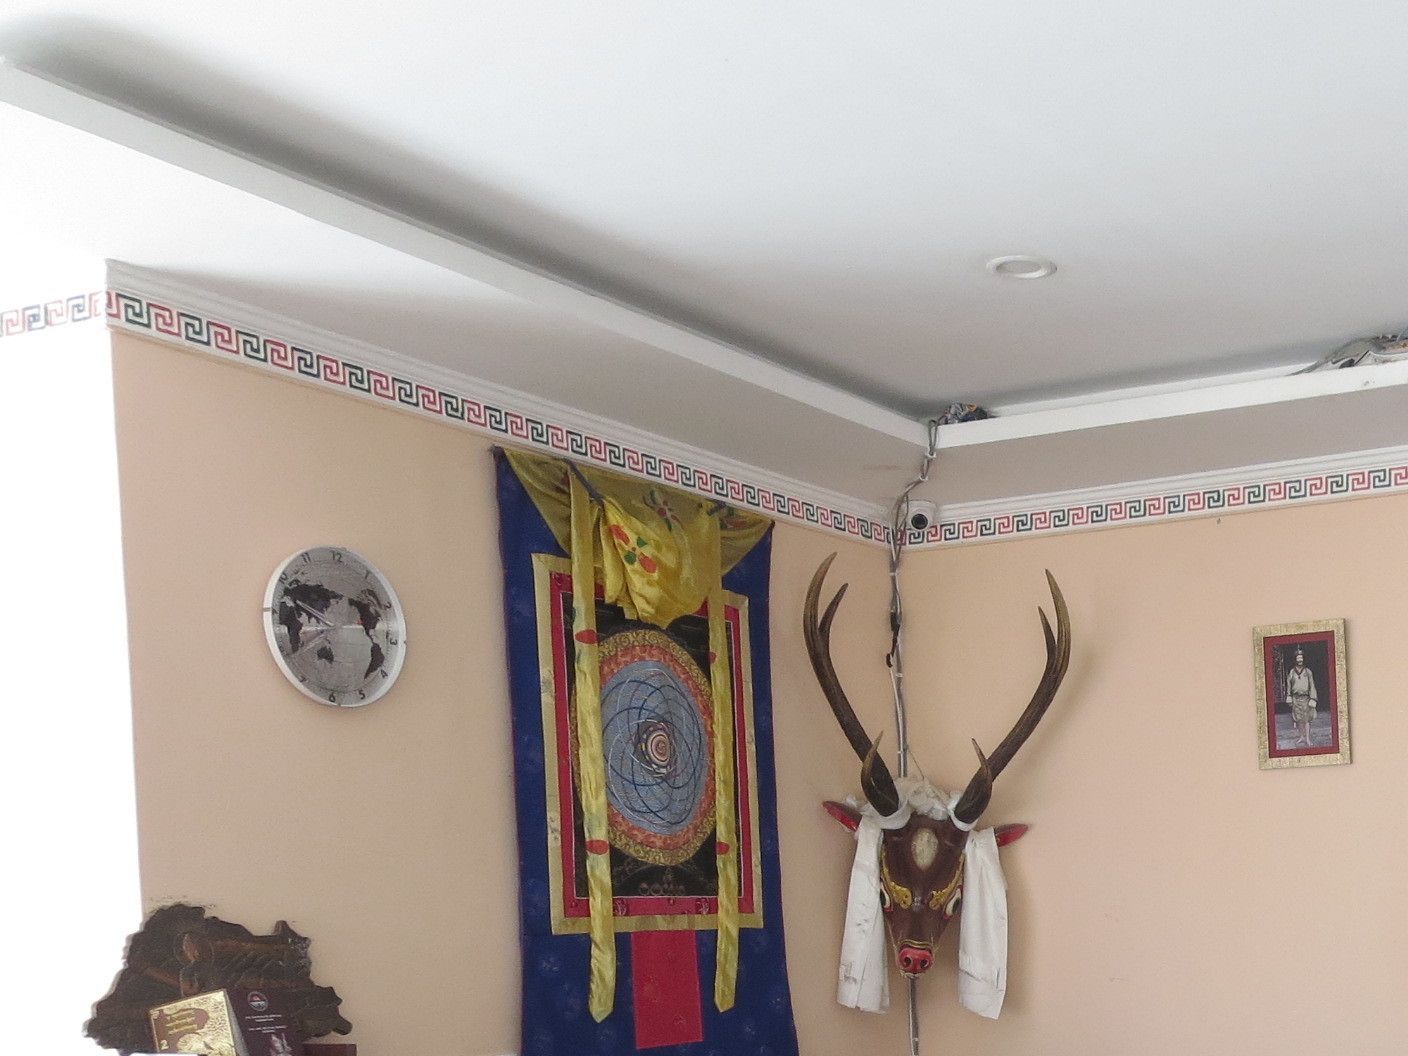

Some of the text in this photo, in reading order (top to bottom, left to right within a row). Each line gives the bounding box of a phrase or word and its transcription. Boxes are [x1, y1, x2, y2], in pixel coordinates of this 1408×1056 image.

[329, 550, 343, 563] 12
[389, 638, 398, 646] 3
[380, 669, 389, 679] 4
[328, 692, 336, 702] 6
[358, 689, 366, 700] 5
